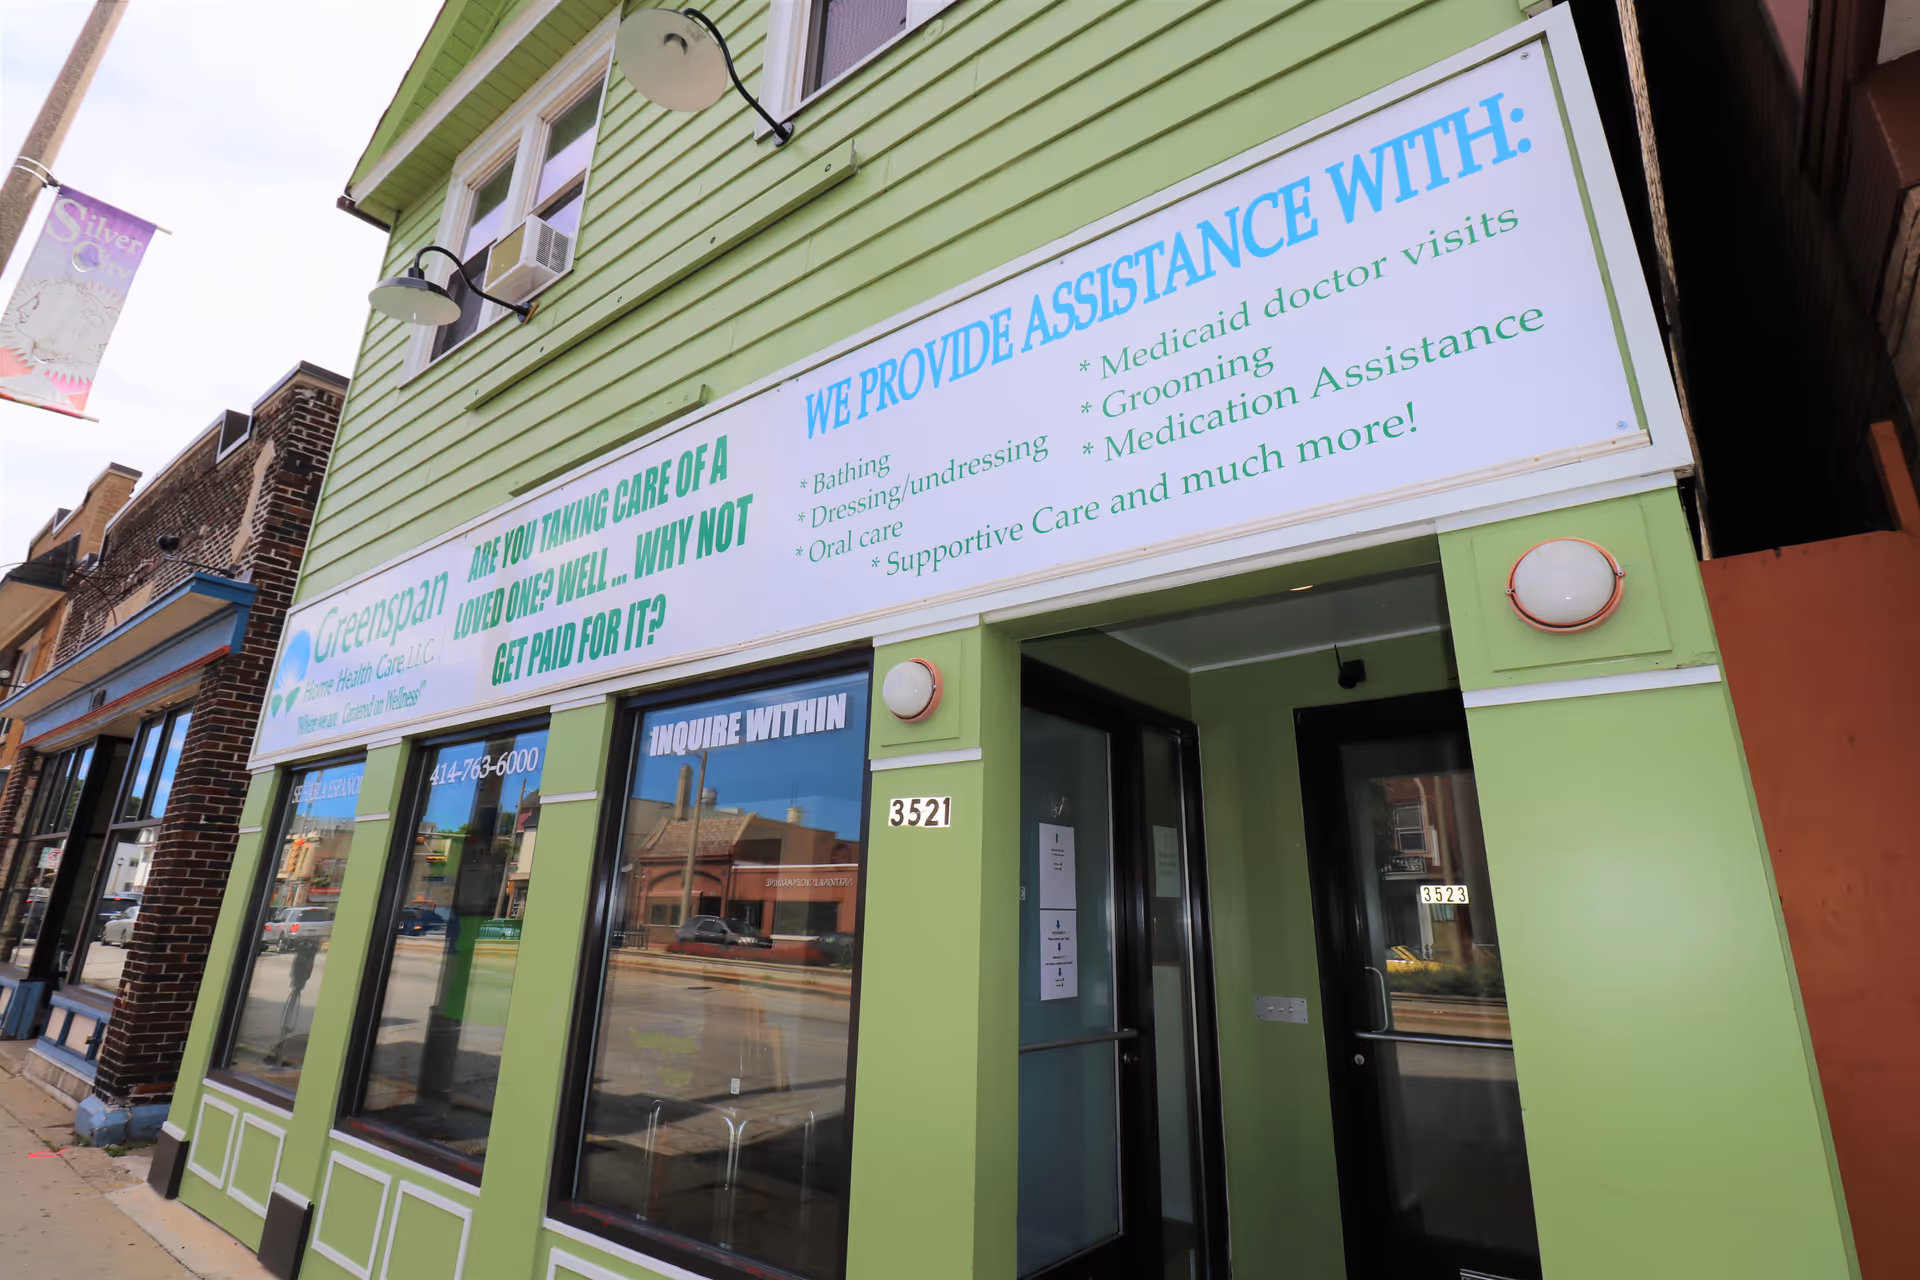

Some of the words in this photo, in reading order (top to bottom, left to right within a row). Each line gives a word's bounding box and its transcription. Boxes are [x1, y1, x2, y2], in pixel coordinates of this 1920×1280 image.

[47, 198, 143, 255] Silver
[804, 376, 851, 440] WE
[857, 306, 1013, 420] PROVIDE
[1020, 174, 1319, 353] ASSISTANCE
[1325, 92, 1532, 224] WITH:
[1099, 300, 1252, 380] Medicaid
[1263, 255, 1388, 318] doctor
[1400, 209, 1519, 265] visits
[1102, 346, 1274, 418] Grooming
[1104, 384, 1300, 462] Medication
[1310, 306, 1545, 399] Assistance
[467, 535, 501, 583] ARE
[502, 519, 538, 569] YOU
[539, 487, 609, 554] TAKING
[612, 458, 672, 524] CARE
[675, 443, 708, 498] OF
[709, 434, 728, 485] A
[811, 434, 1049, 528] Dressing/undressing
[813, 453, 891, 495] Bathing
[886, 522, 1023, 577] Supportive
[1032, 500, 1100, 534] Care
[1110, 472, 1171, 515] and
[1181, 443, 1286, 495] much
[1295, 400, 1418, 464] more!
[453, 587, 505, 641] LOVED
[505, 567, 554, 623] ONE?
[634, 514, 694, 580] WHY
[696, 493, 754, 560] NOT
[808, 529, 852, 563] Oral
[859, 521, 904, 548] care
[314, 570, 449, 664] Greenspan
[491, 635, 529, 686] GET
[527, 621, 576, 677] PAID
[577, 607, 622, 664] FOR
[624, 593, 667, 652] IT?
[304, 679, 335, 703] Home
[336, 661, 373, 692] Health
[650, 711, 741, 757] INQUIRE
[746, 692, 847, 742] WITHIN
[429, 747, 540, 786] 414-763-6000
[889, 797, 951, 827] 3521
[1423, 886, 1467, 903] 3523
